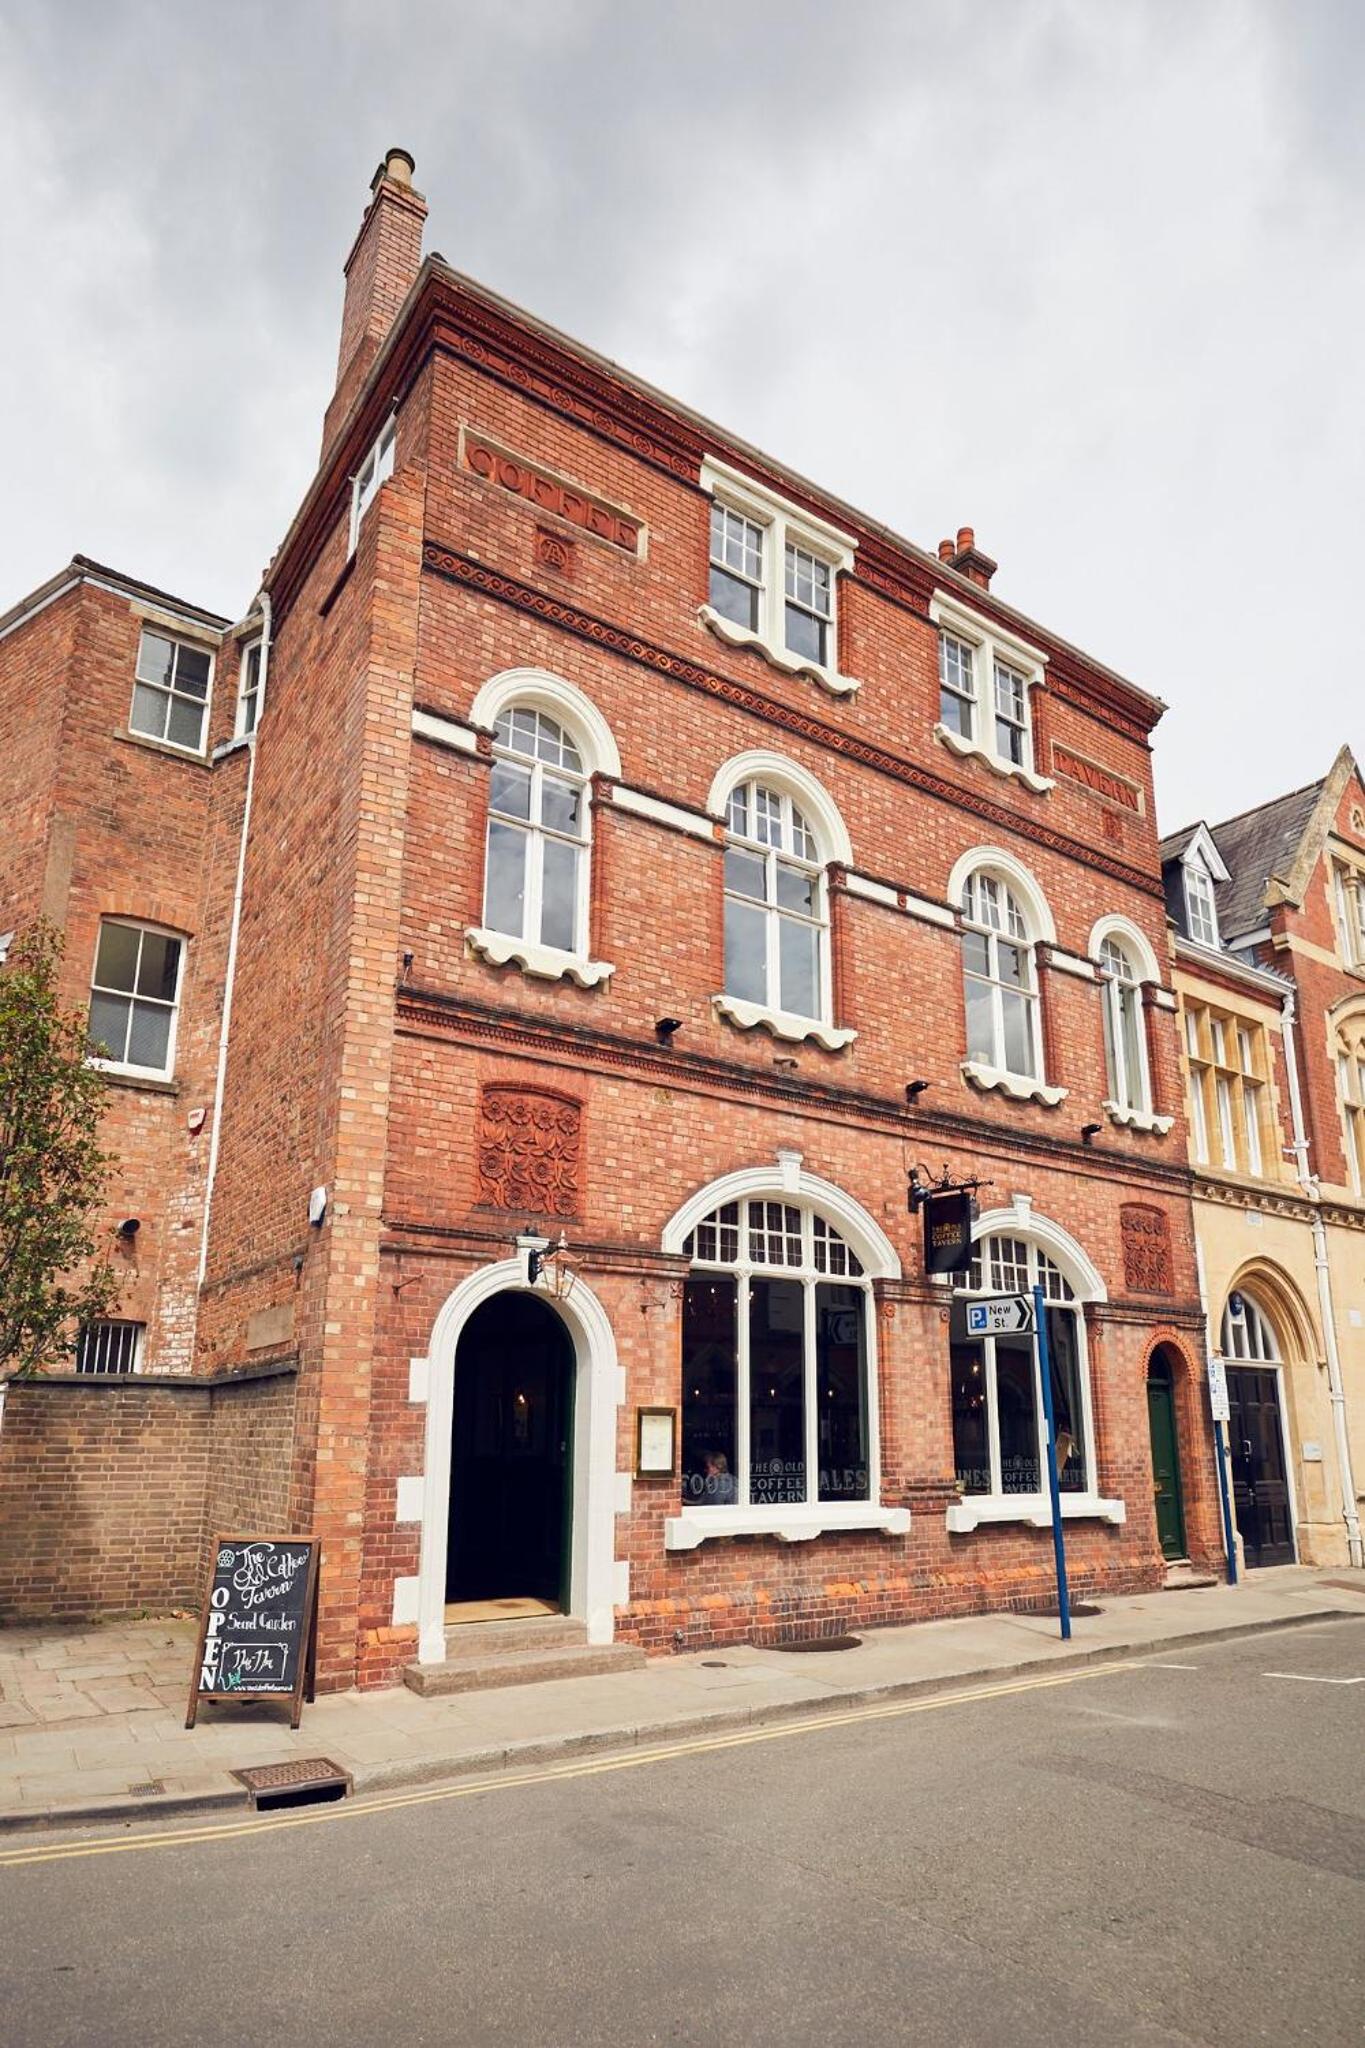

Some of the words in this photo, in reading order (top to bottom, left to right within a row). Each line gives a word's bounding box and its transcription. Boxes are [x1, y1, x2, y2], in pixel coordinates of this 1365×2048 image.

[466, 444, 638, 553] COFFEE
[1054, 749, 1138, 811] TAVERN
[989, 1305, 1011, 1315] New
[750, 1463, 768, 1473] THE
[785, 1462, 805, 1473] OLD
[1002, 1471, 1039, 1482] OFFEE
[750, 1478, 805, 1490] COFFEE
[818, 1469, 868, 1491] ALES
[957, 1469, 991, 1487] INES
[1003, 1483, 1040, 1493] AVERN
[750, 1490, 805, 1504] TAVERN
[236, 1542, 275, 1568] The
[233, 1563, 269, 1590] Old
[267, 1549, 309, 1579] Coffee
[241, 1581, 294, 1609] Tavern
[259, 1611, 297, 1631] Garden
[199, 1587, 230, 1690] OPEN
